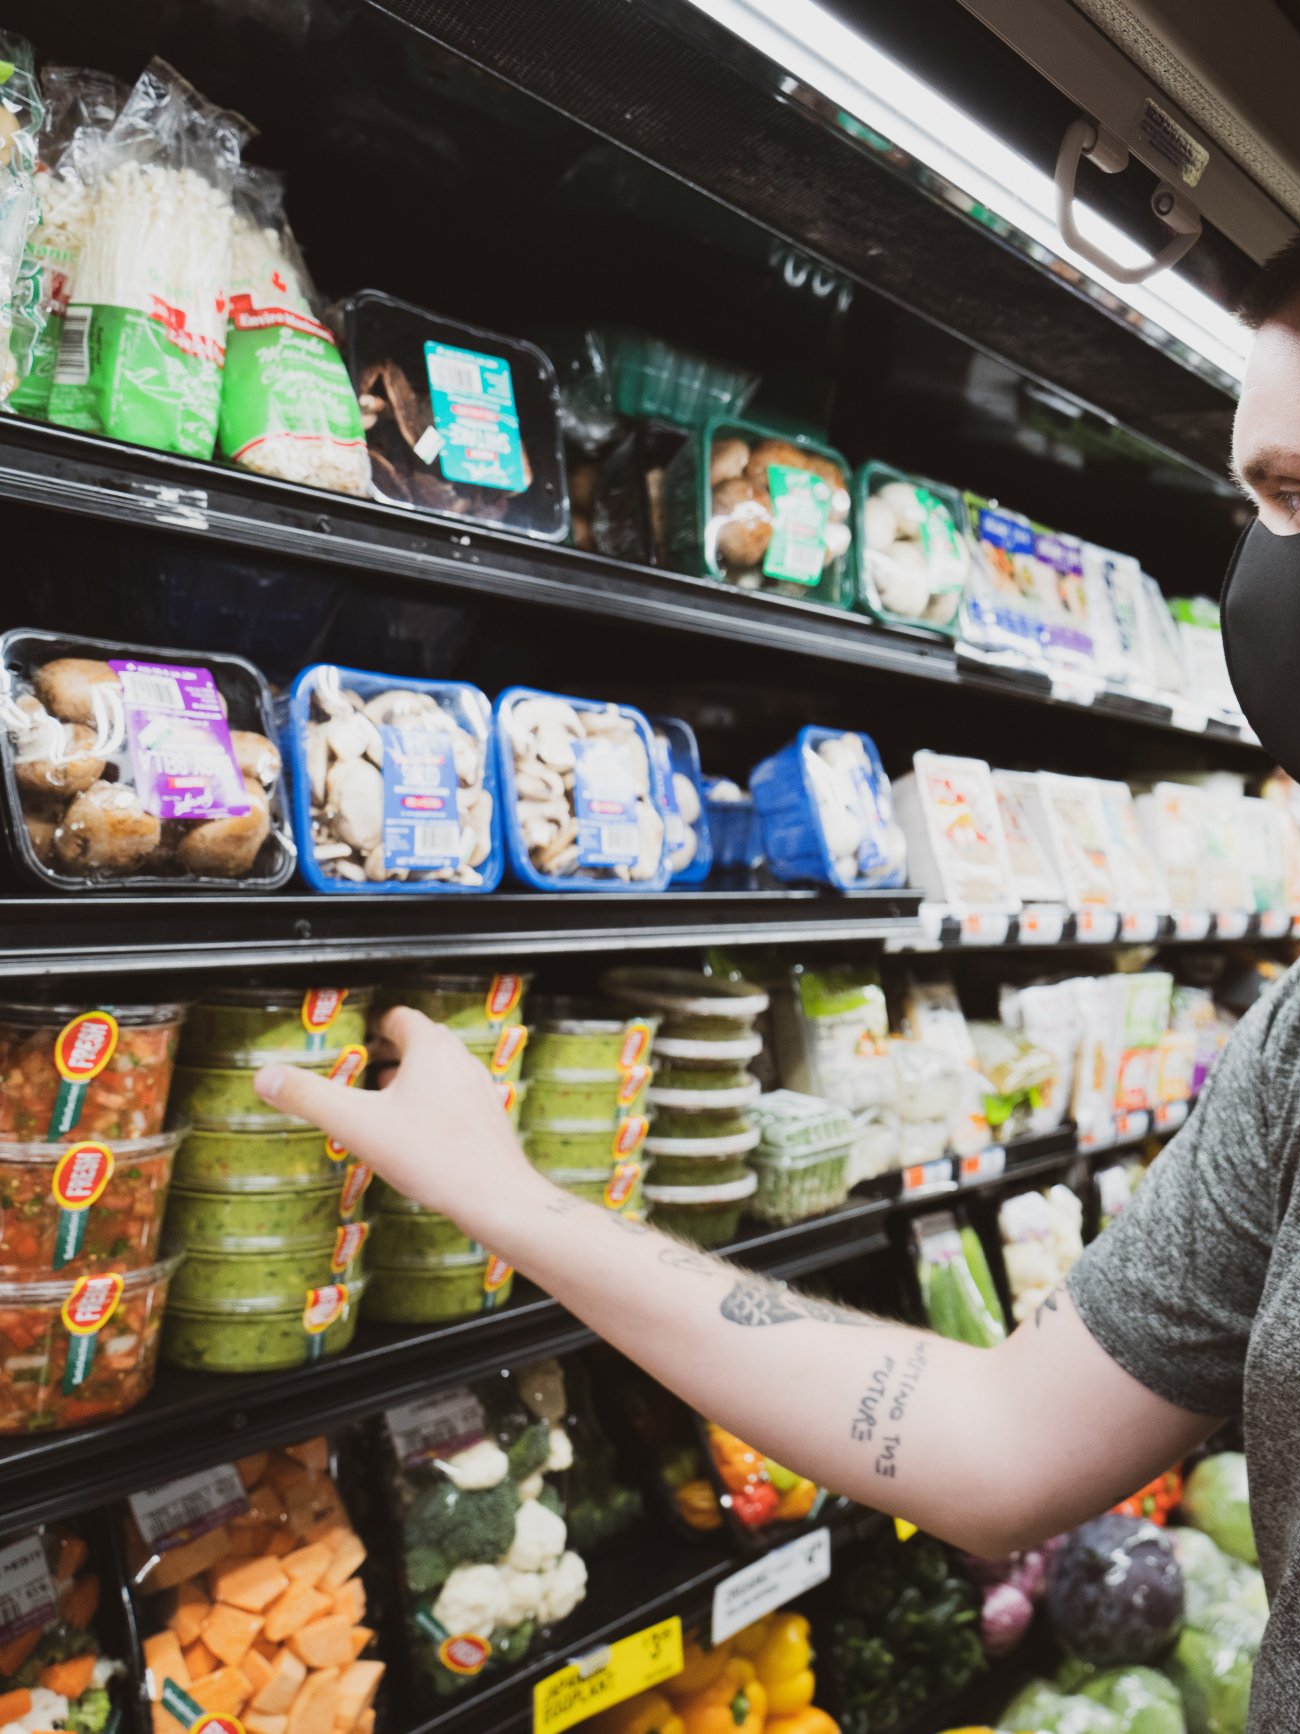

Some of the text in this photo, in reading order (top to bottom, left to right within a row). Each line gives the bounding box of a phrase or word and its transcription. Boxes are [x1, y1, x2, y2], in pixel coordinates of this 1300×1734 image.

[67, 1022, 108, 1068] FRESH
[65, 1153, 103, 1197] FRESH
[75, 1278, 114, 1322] FRESH
[850, 1355, 894, 1441] FUTURE
